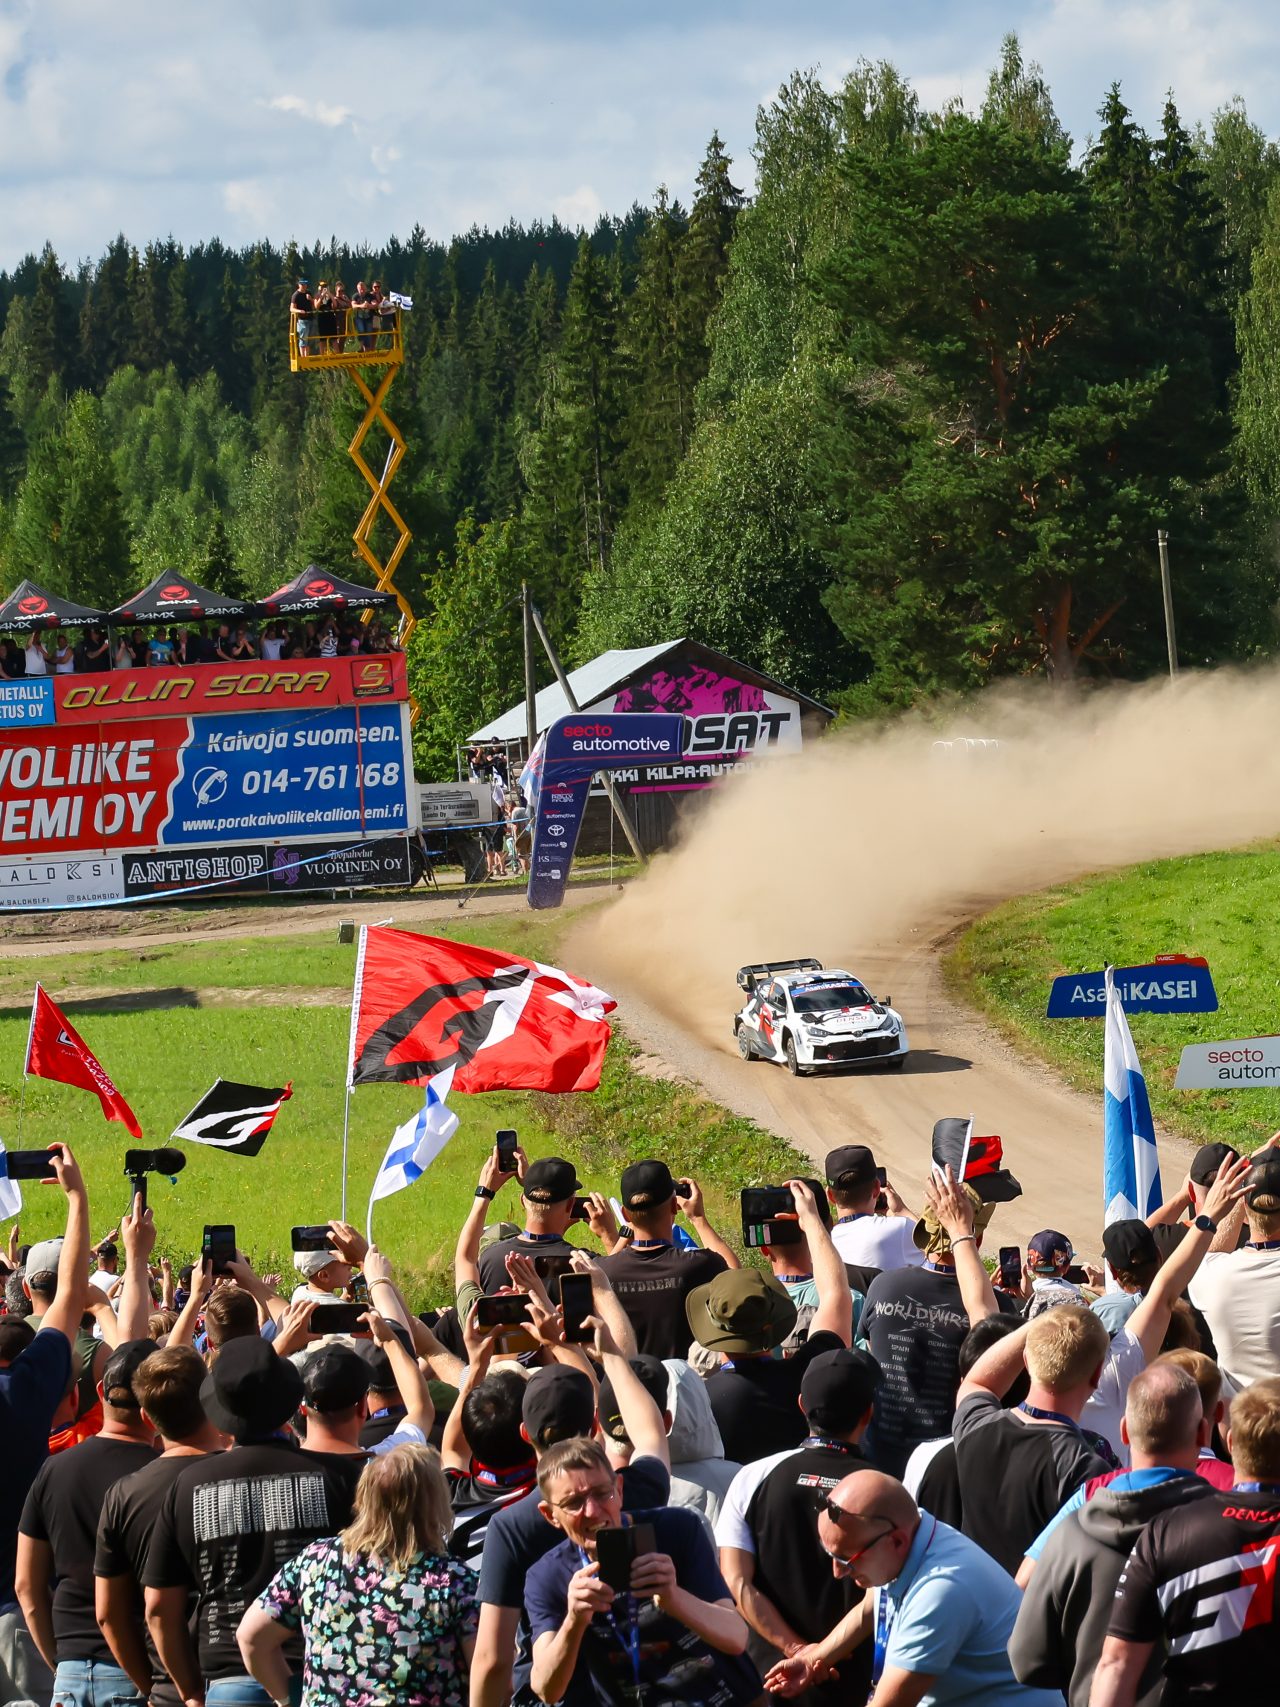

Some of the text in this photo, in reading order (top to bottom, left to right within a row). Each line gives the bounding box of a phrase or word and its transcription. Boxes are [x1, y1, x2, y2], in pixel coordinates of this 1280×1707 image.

[205, 606, 244, 615] 24MX
[280, 601, 319, 612] 24MX
[61, 617, 99, 625] 24MX
[136, 611, 175, 619] 24MX
[0, 621, 32, 630] 4MX
[62, 671, 330, 709] OLLIN SORA
[0, 703, 44, 719] TUS OY
[563, 723, 613, 737] secto
[207, 726, 400, 754] Kaivoja suomeen.
[572, 737, 671, 752] automotive
[242, 762, 400, 796] 014-761 168
[0, 791, 157, 842] EMI OY
[182, 803, 405, 832] www.porakaivoliikekallionemi.fi
[8, 863, 114, 882] ALOKSI
[128, 855, 263, 884] ANTISHOP
[304, 858, 403, 875] VUORINEN OY
[1208, 1048, 1264, 1064] secto
[874, 1300, 970, 1328] WORLDWIRE
